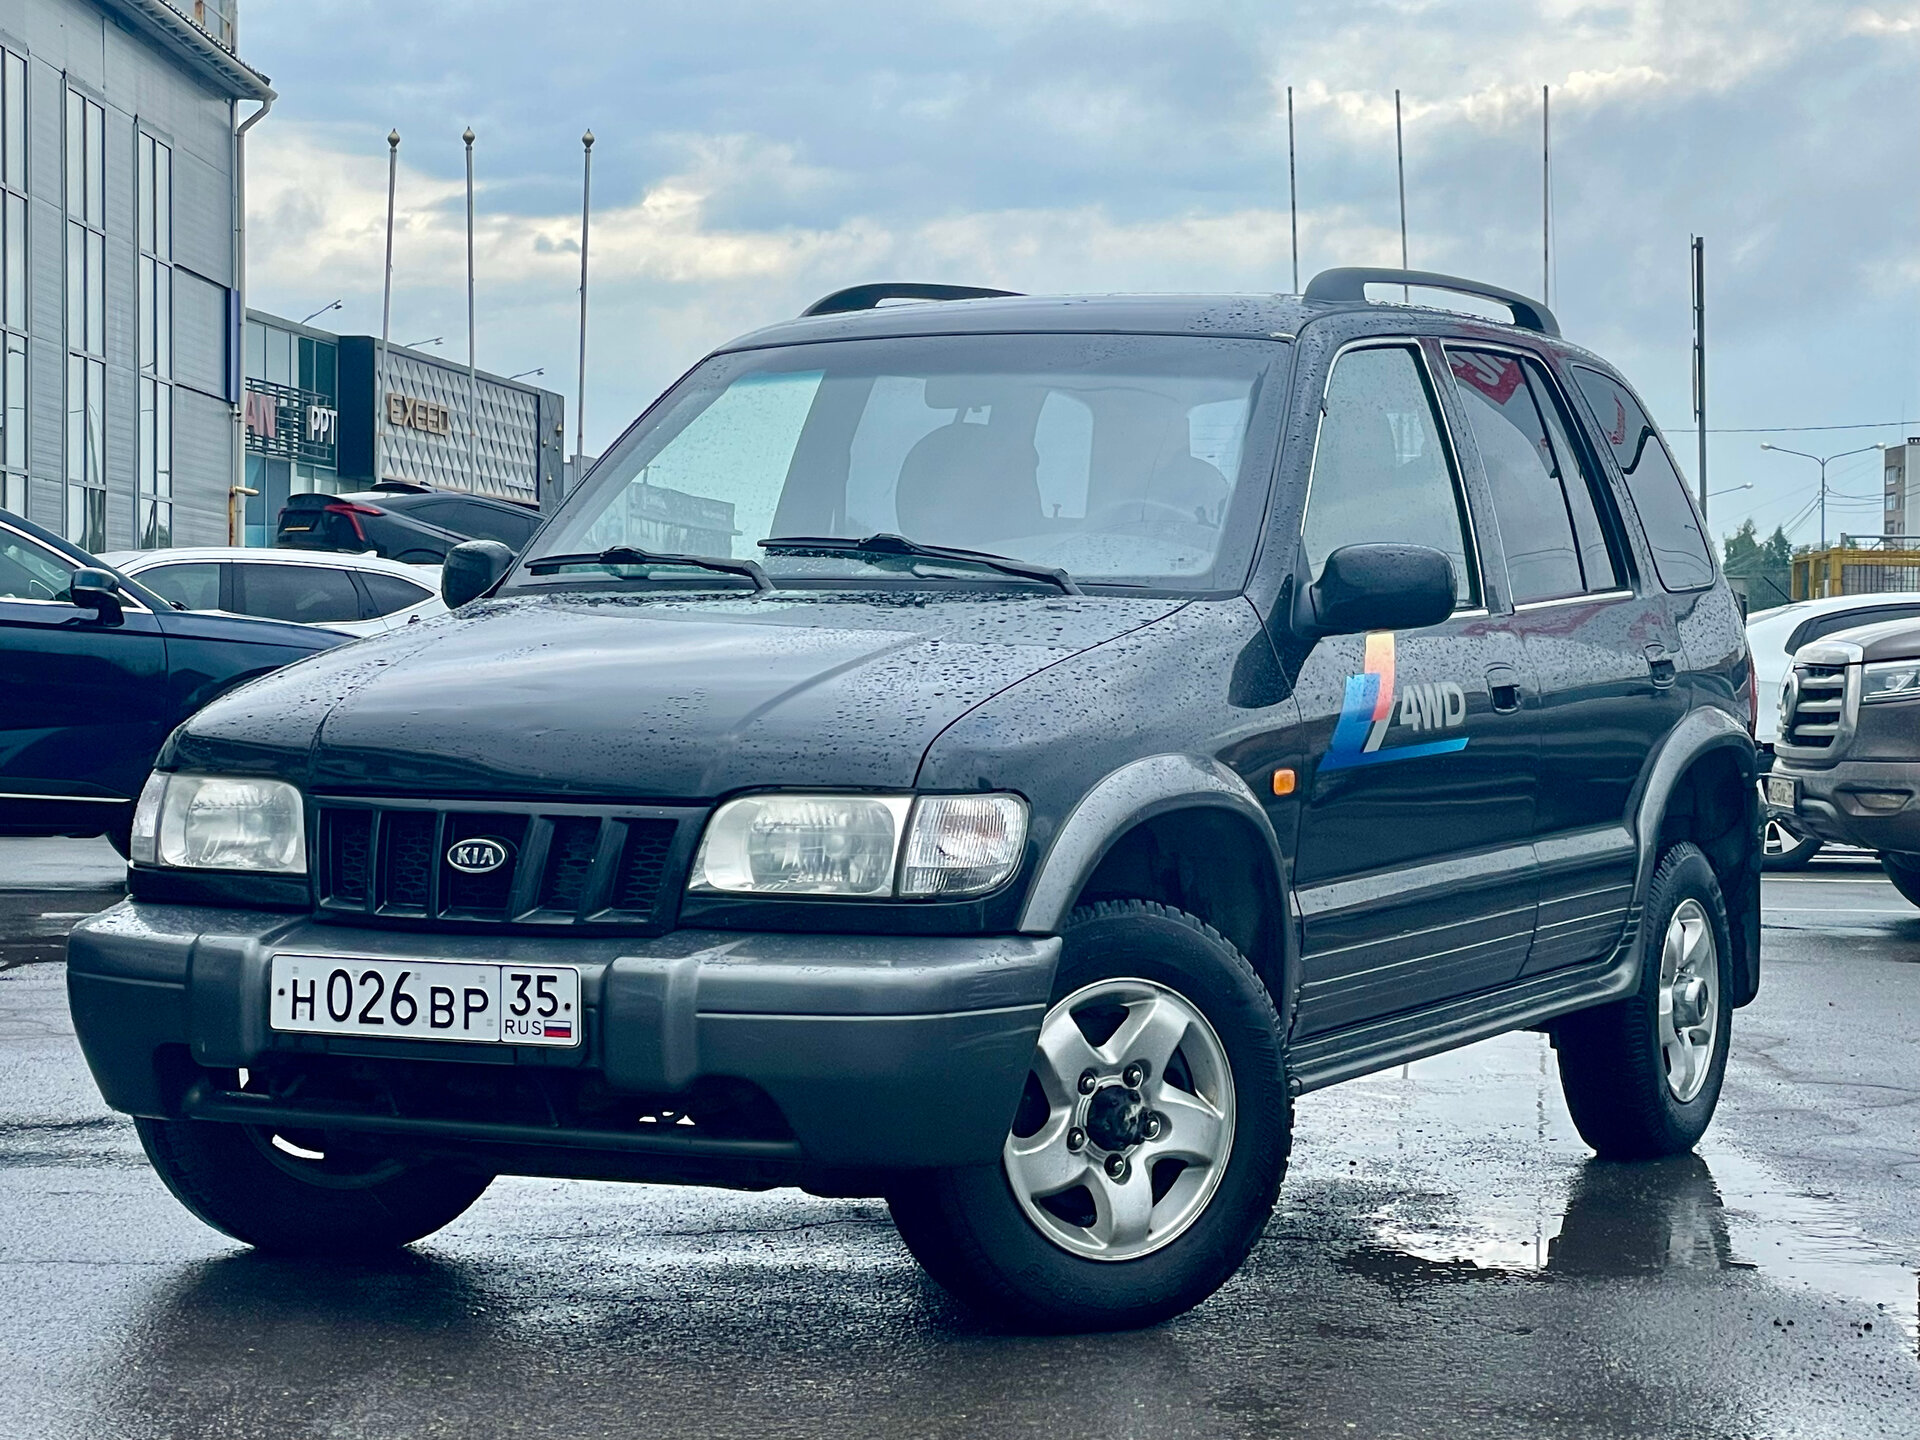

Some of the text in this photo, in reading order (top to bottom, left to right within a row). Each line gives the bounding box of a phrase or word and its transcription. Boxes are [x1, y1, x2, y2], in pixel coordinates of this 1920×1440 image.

[388, 393, 450, 437] EXEED
[1400, 681, 1466, 731] 4WD
[457, 847, 495, 865] KIA
[509, 973, 559, 1017] 35
[504, 1019, 542, 1036] RUS
